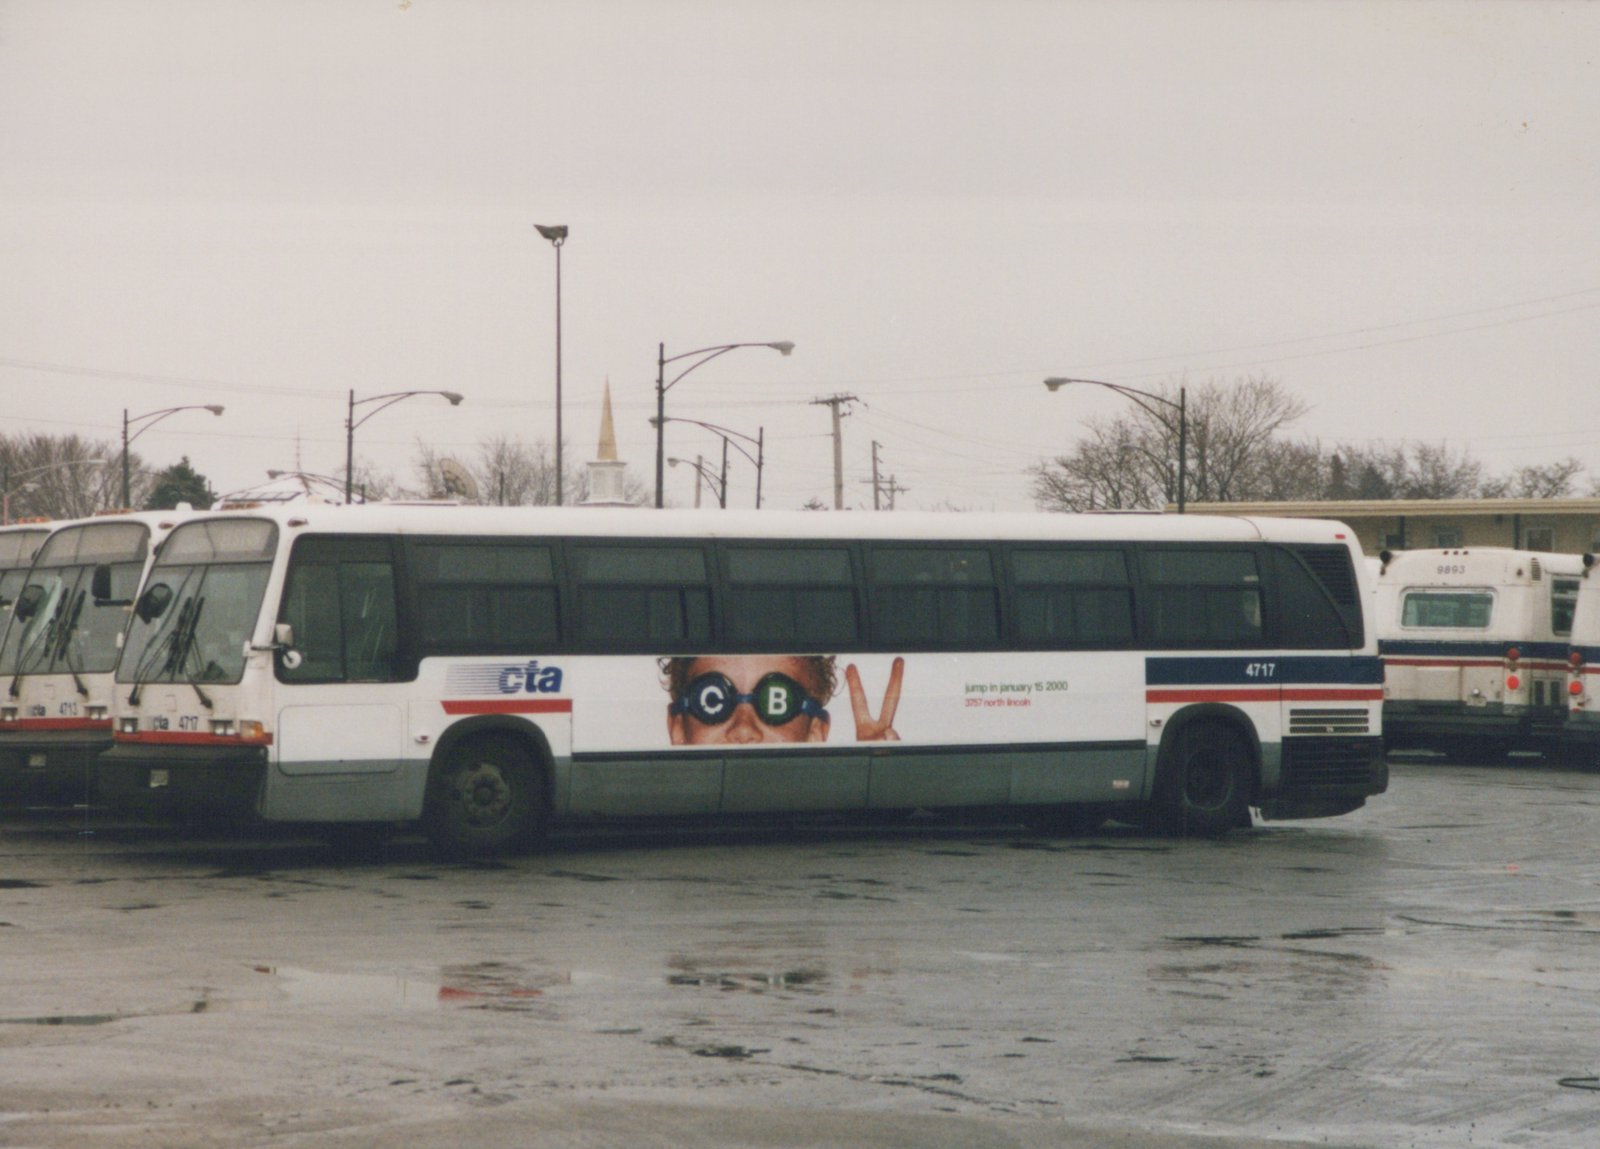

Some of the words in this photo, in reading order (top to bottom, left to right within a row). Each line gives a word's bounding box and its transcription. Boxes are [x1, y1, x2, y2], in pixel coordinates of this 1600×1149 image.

[1246, 663, 1275, 676] 4717
[499, 660, 563, 694] cta
[965, 683, 988, 693] jump
[1000, 682, 1032, 694] january
[1046, 681, 1068, 691] 2000
[179, 715, 199, 731] 4717
